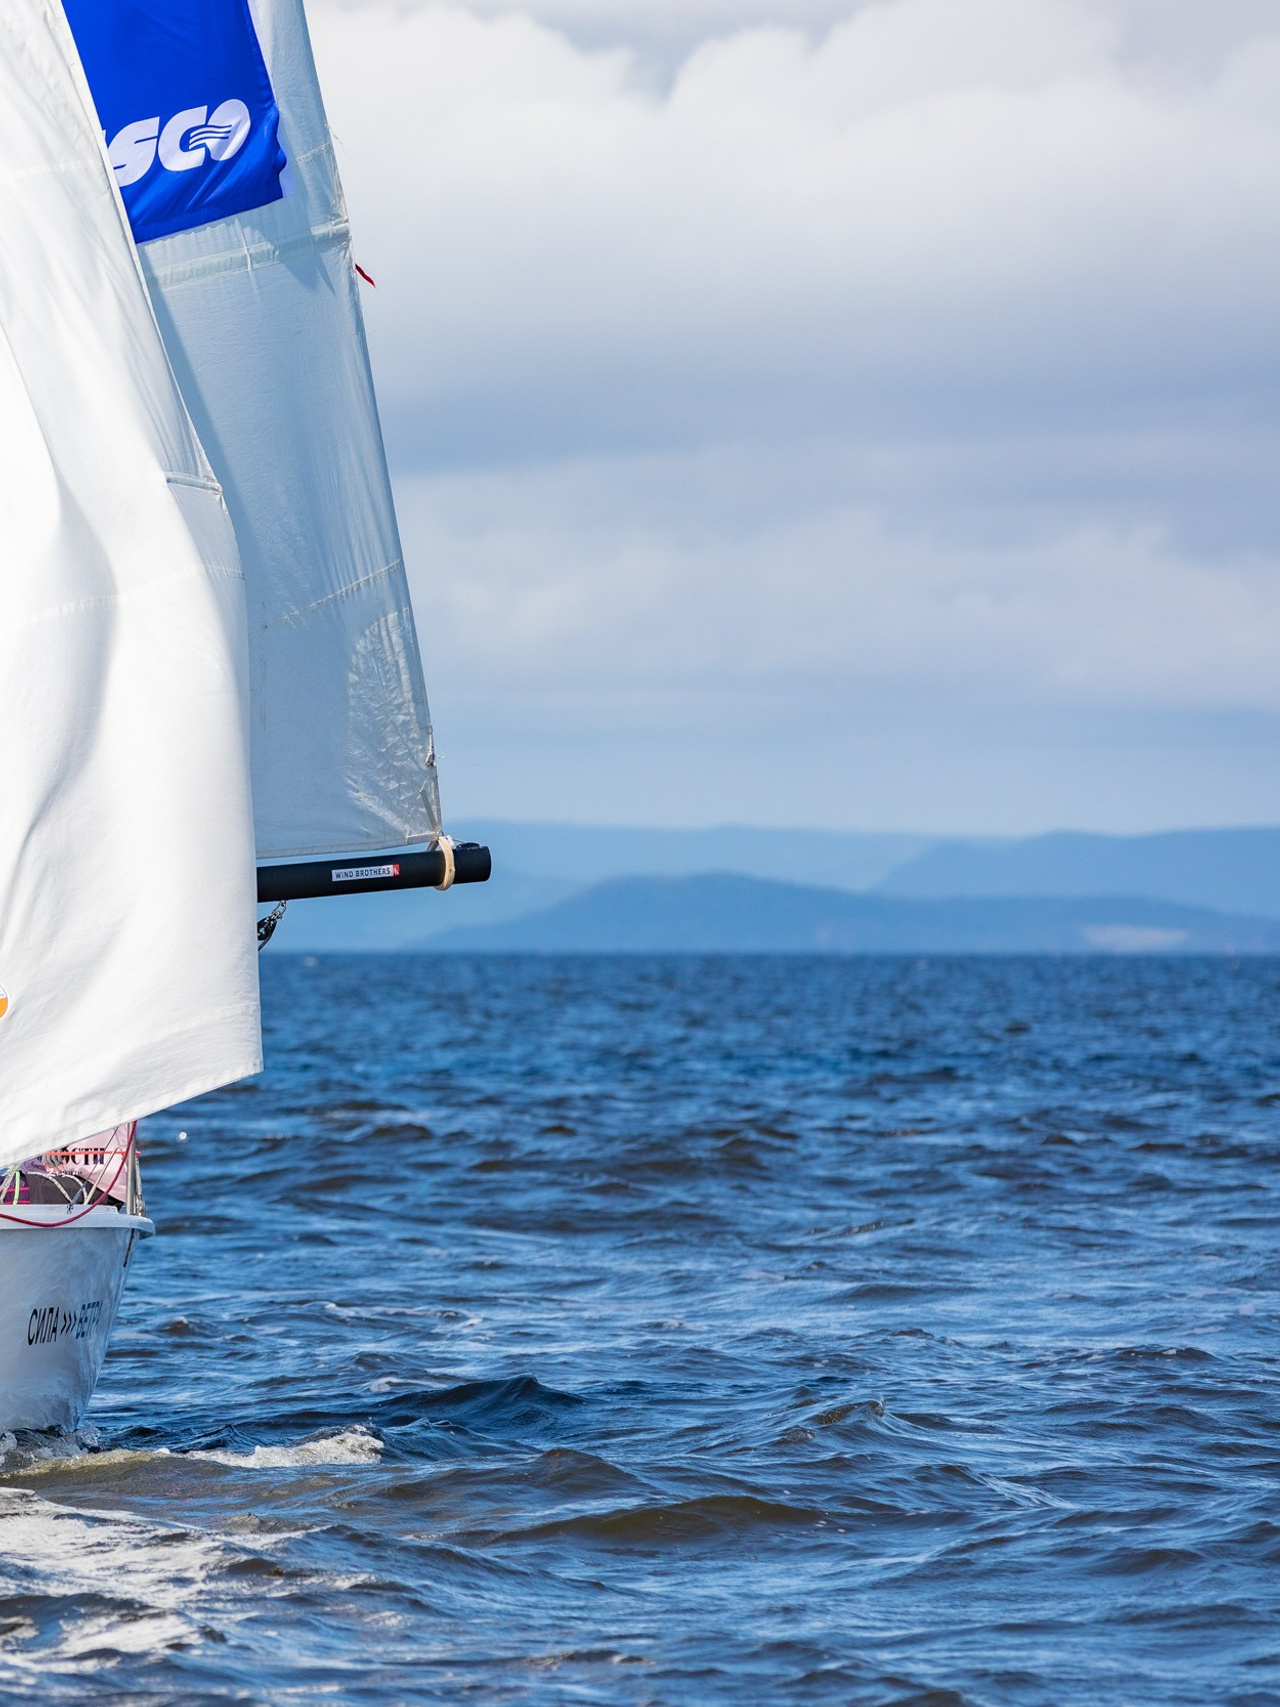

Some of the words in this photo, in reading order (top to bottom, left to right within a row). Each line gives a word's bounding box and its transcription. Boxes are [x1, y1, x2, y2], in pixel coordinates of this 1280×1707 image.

[101, 99, 251, 187] SCO
[335, 870, 354, 879] WIND
[355, 868, 391, 877] BROTHERS
[27, 1307, 60, 1345] СИЛА
[75, 1300, 103, 1339] ВЕТРА
